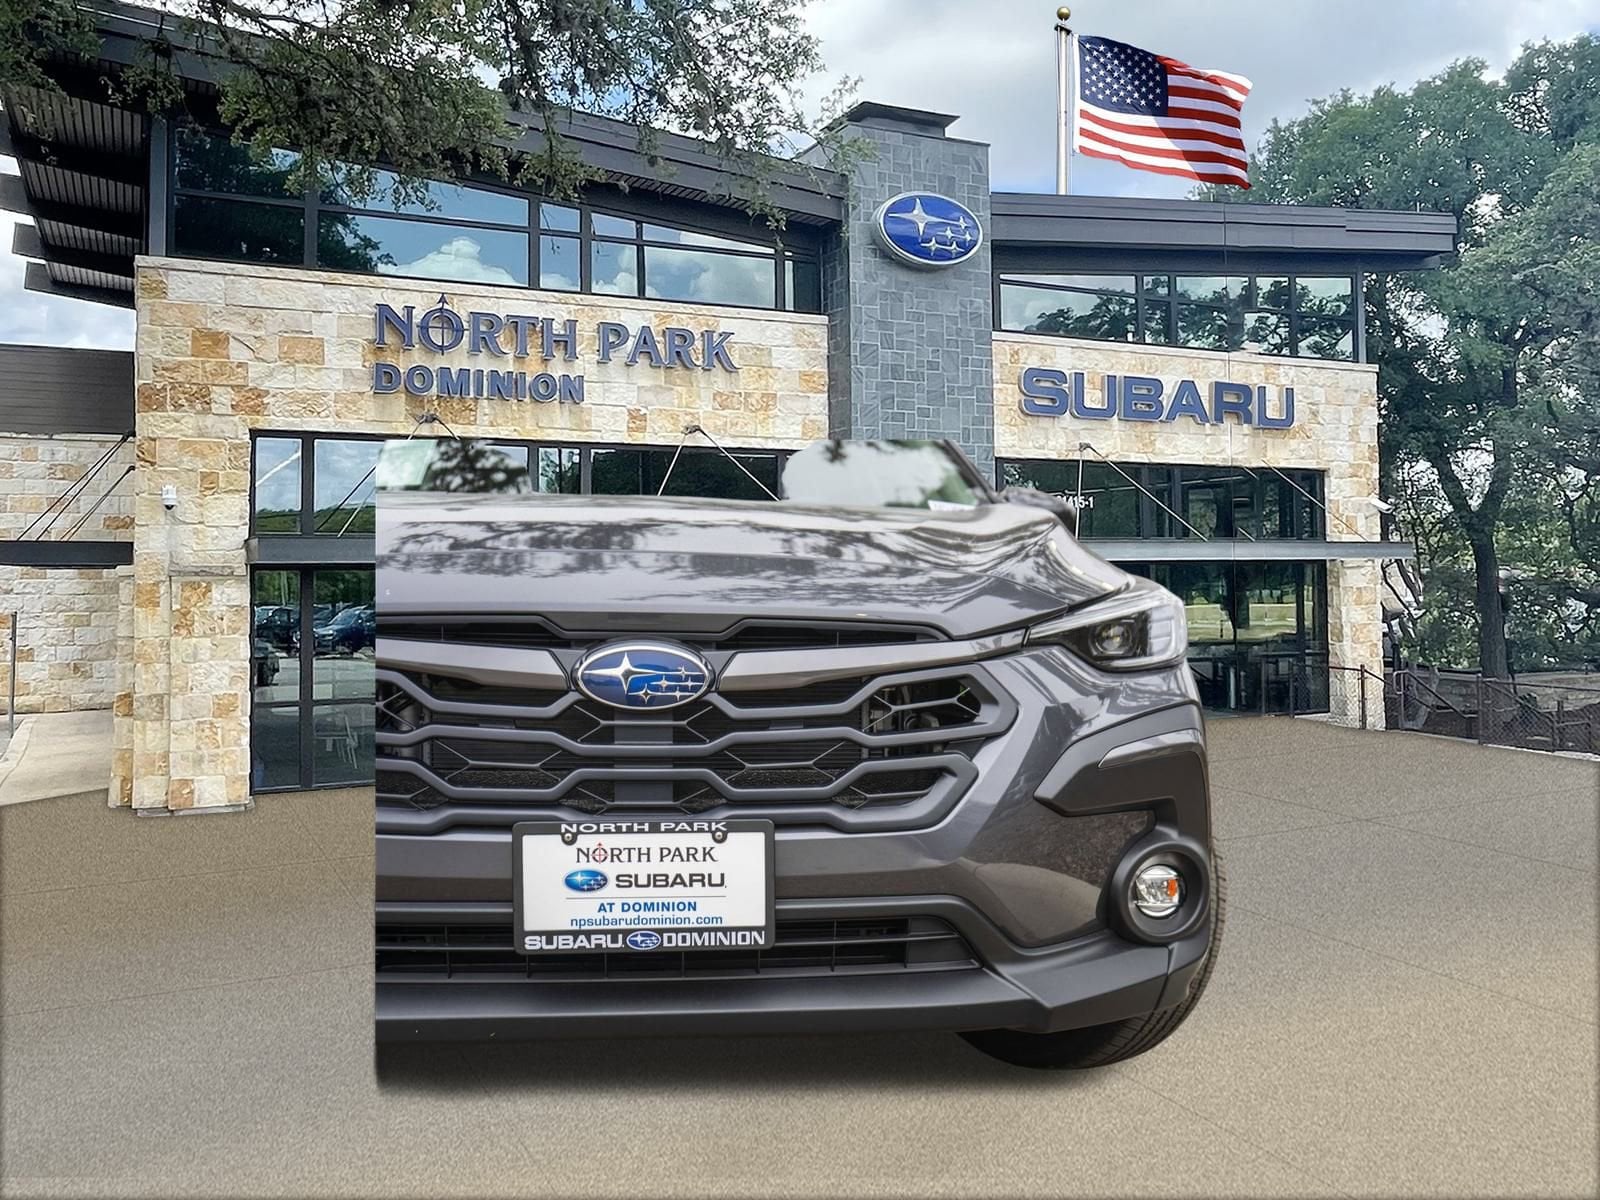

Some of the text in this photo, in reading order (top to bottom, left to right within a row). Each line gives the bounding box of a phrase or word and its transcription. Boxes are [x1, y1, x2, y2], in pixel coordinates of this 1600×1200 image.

[374, 293, 741, 373] NORTH PARK
[373, 361, 584, 404] DOMINION
[1018, 366, 1295, 429] SUBARU
[560, 821, 728, 833] NORTH PARK
[576, 843, 719, 865] NORTH PARK
[597, 901, 697, 913] AT DOMINION
[570, 914, 723, 928] npsubarudominion.com
[663, 930, 766, 946] DOMINION
